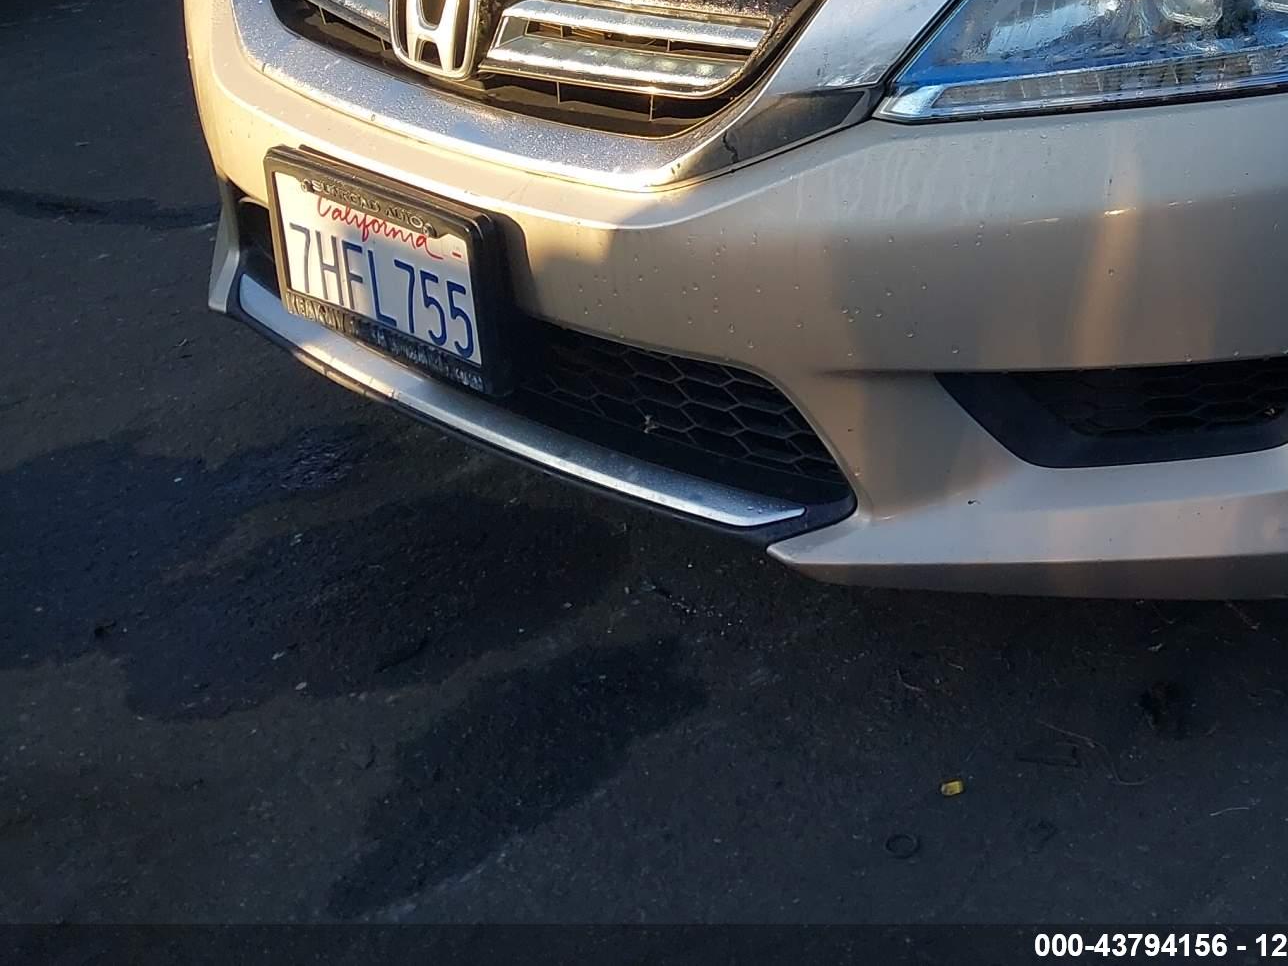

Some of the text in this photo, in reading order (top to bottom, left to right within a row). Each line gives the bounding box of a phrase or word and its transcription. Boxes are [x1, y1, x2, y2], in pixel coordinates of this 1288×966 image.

[316, 194, 444, 260] California
[385, 206, 424, 229] AUTO
[288, 221, 475, 360] 7HFL755
